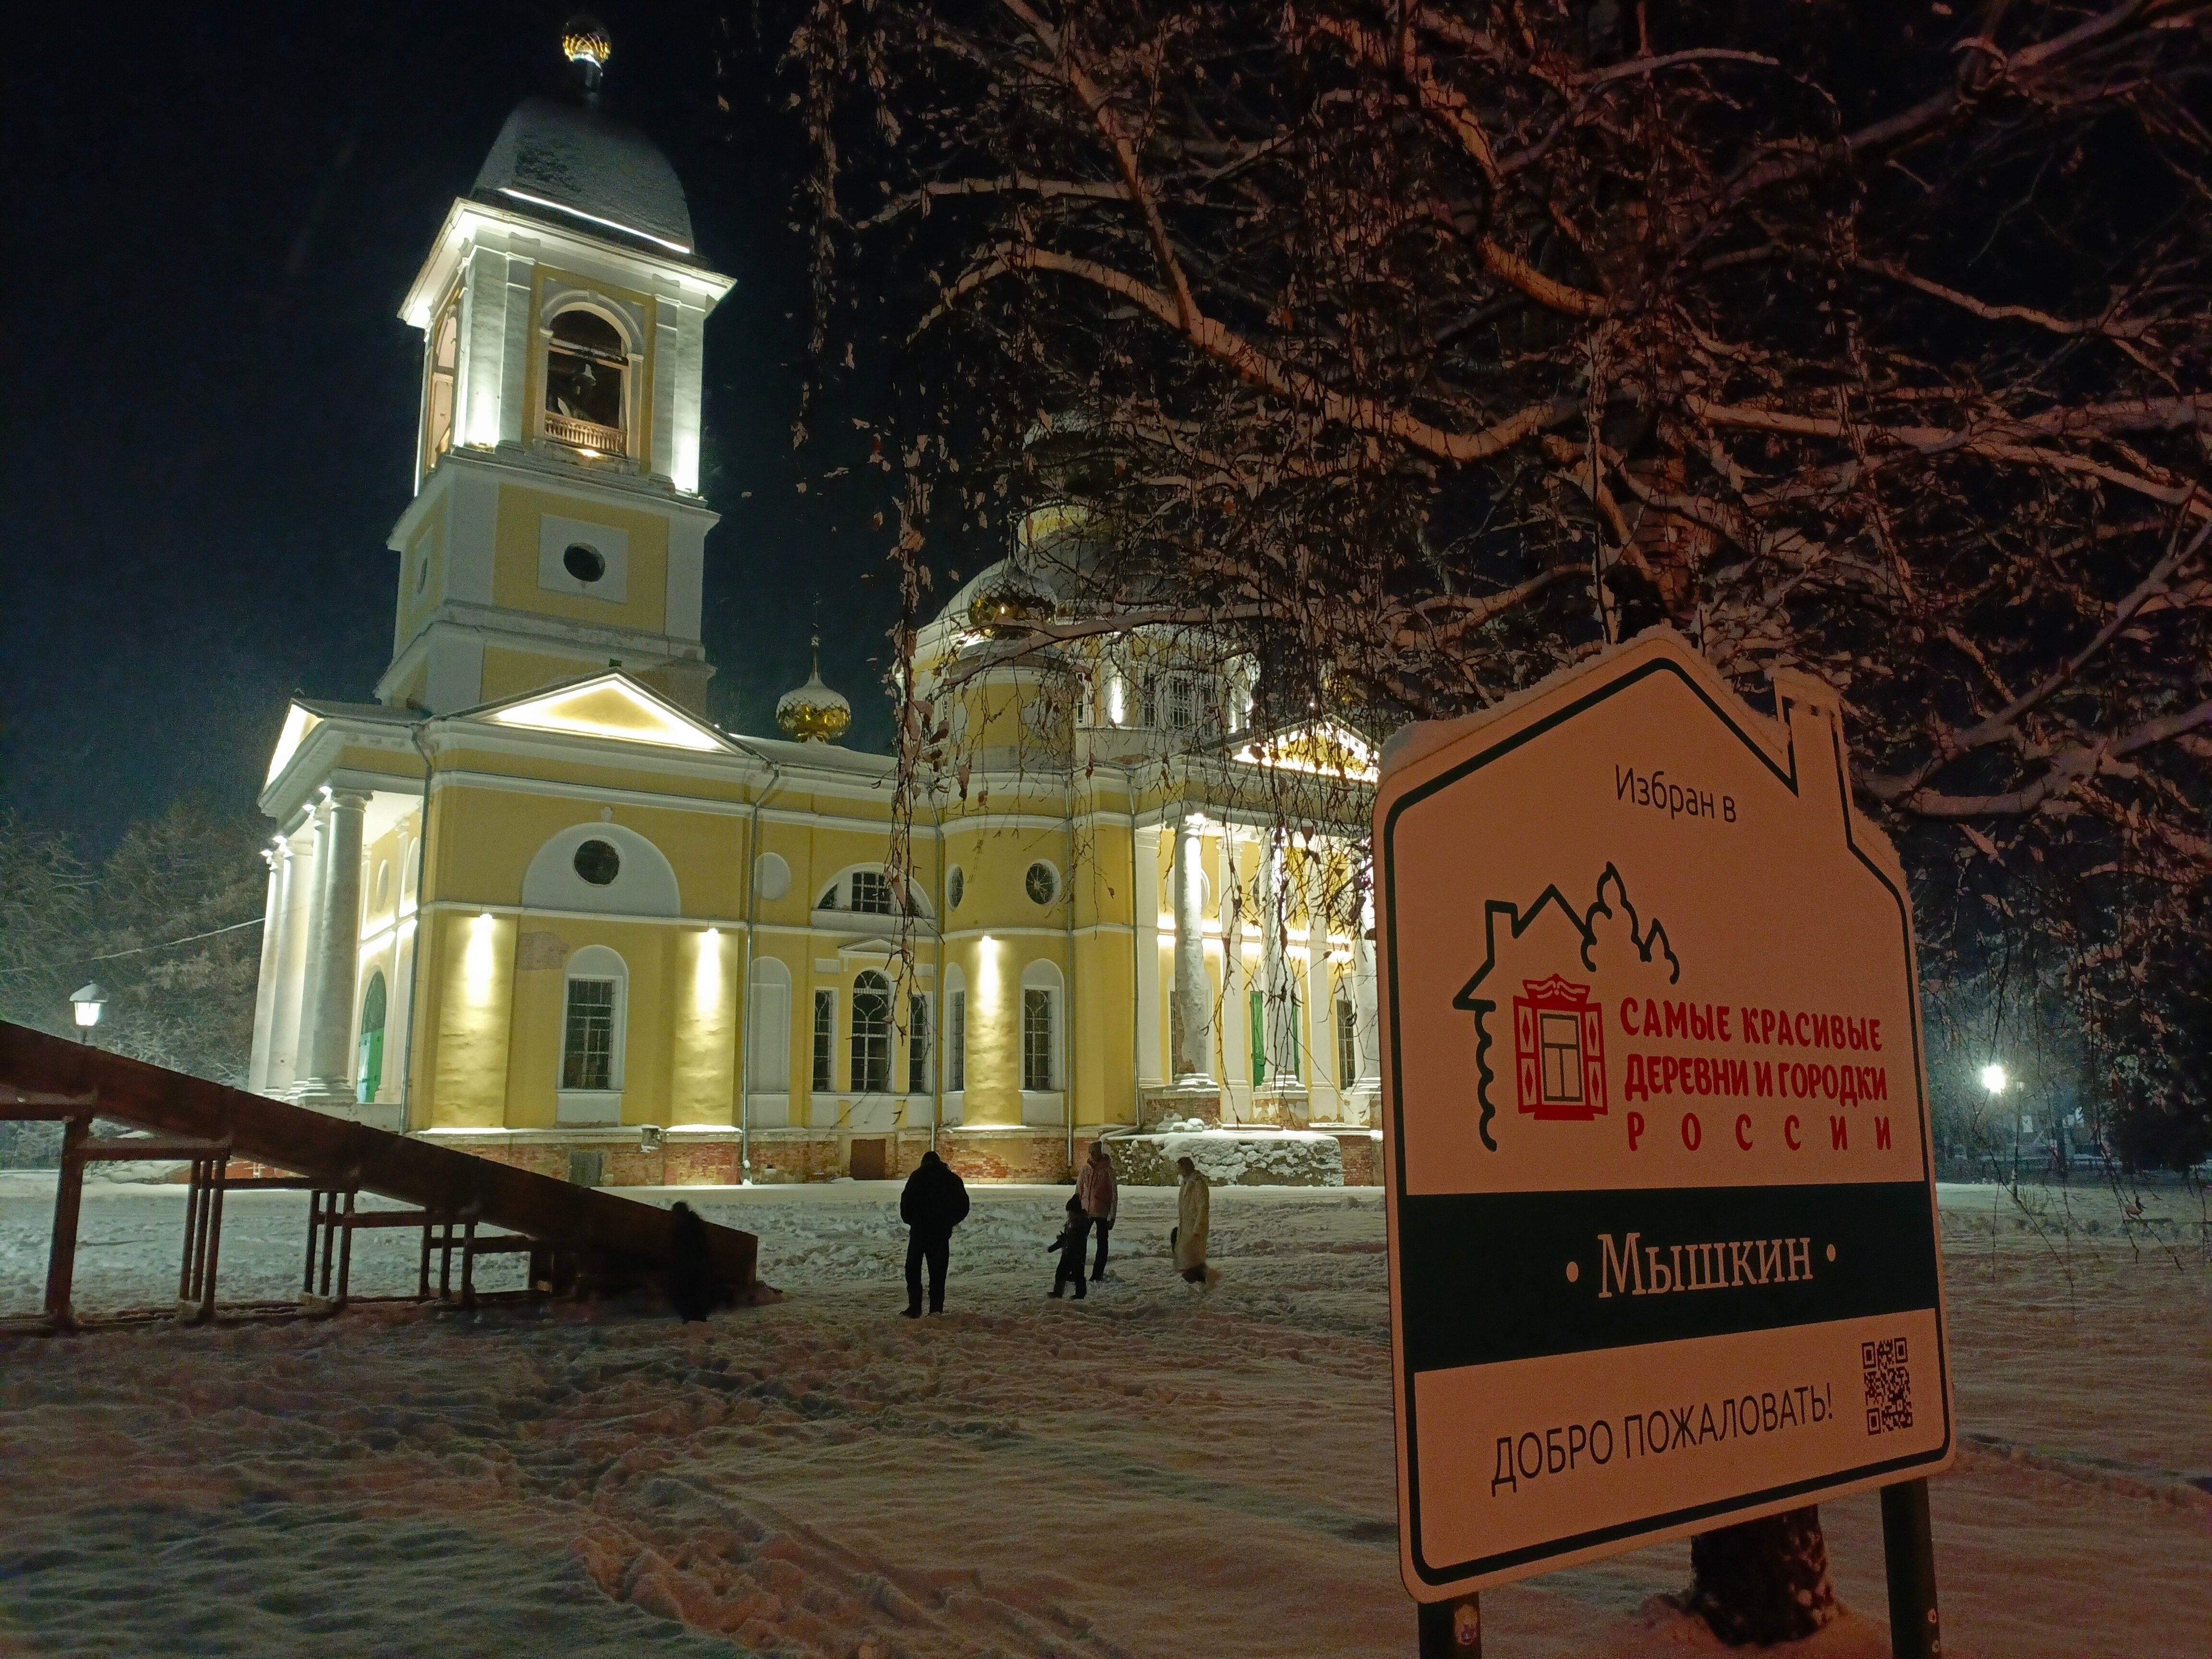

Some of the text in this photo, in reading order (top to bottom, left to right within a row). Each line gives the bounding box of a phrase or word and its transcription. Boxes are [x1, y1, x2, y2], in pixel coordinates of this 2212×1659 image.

[1615, 764, 1737, 823] Избран в
[1619, 996, 1883, 1052] САМЫЕ КРАСИВЫЕ
[1624, 1053, 1888, 1107] ДЕРЕВНИ И ГОРОДКИ
[1597, 1232, 1814, 1298] Мышкин
[1491, 1382, 1832, 1498] ДОБРО ПОЖАЛОВАТЬ!
